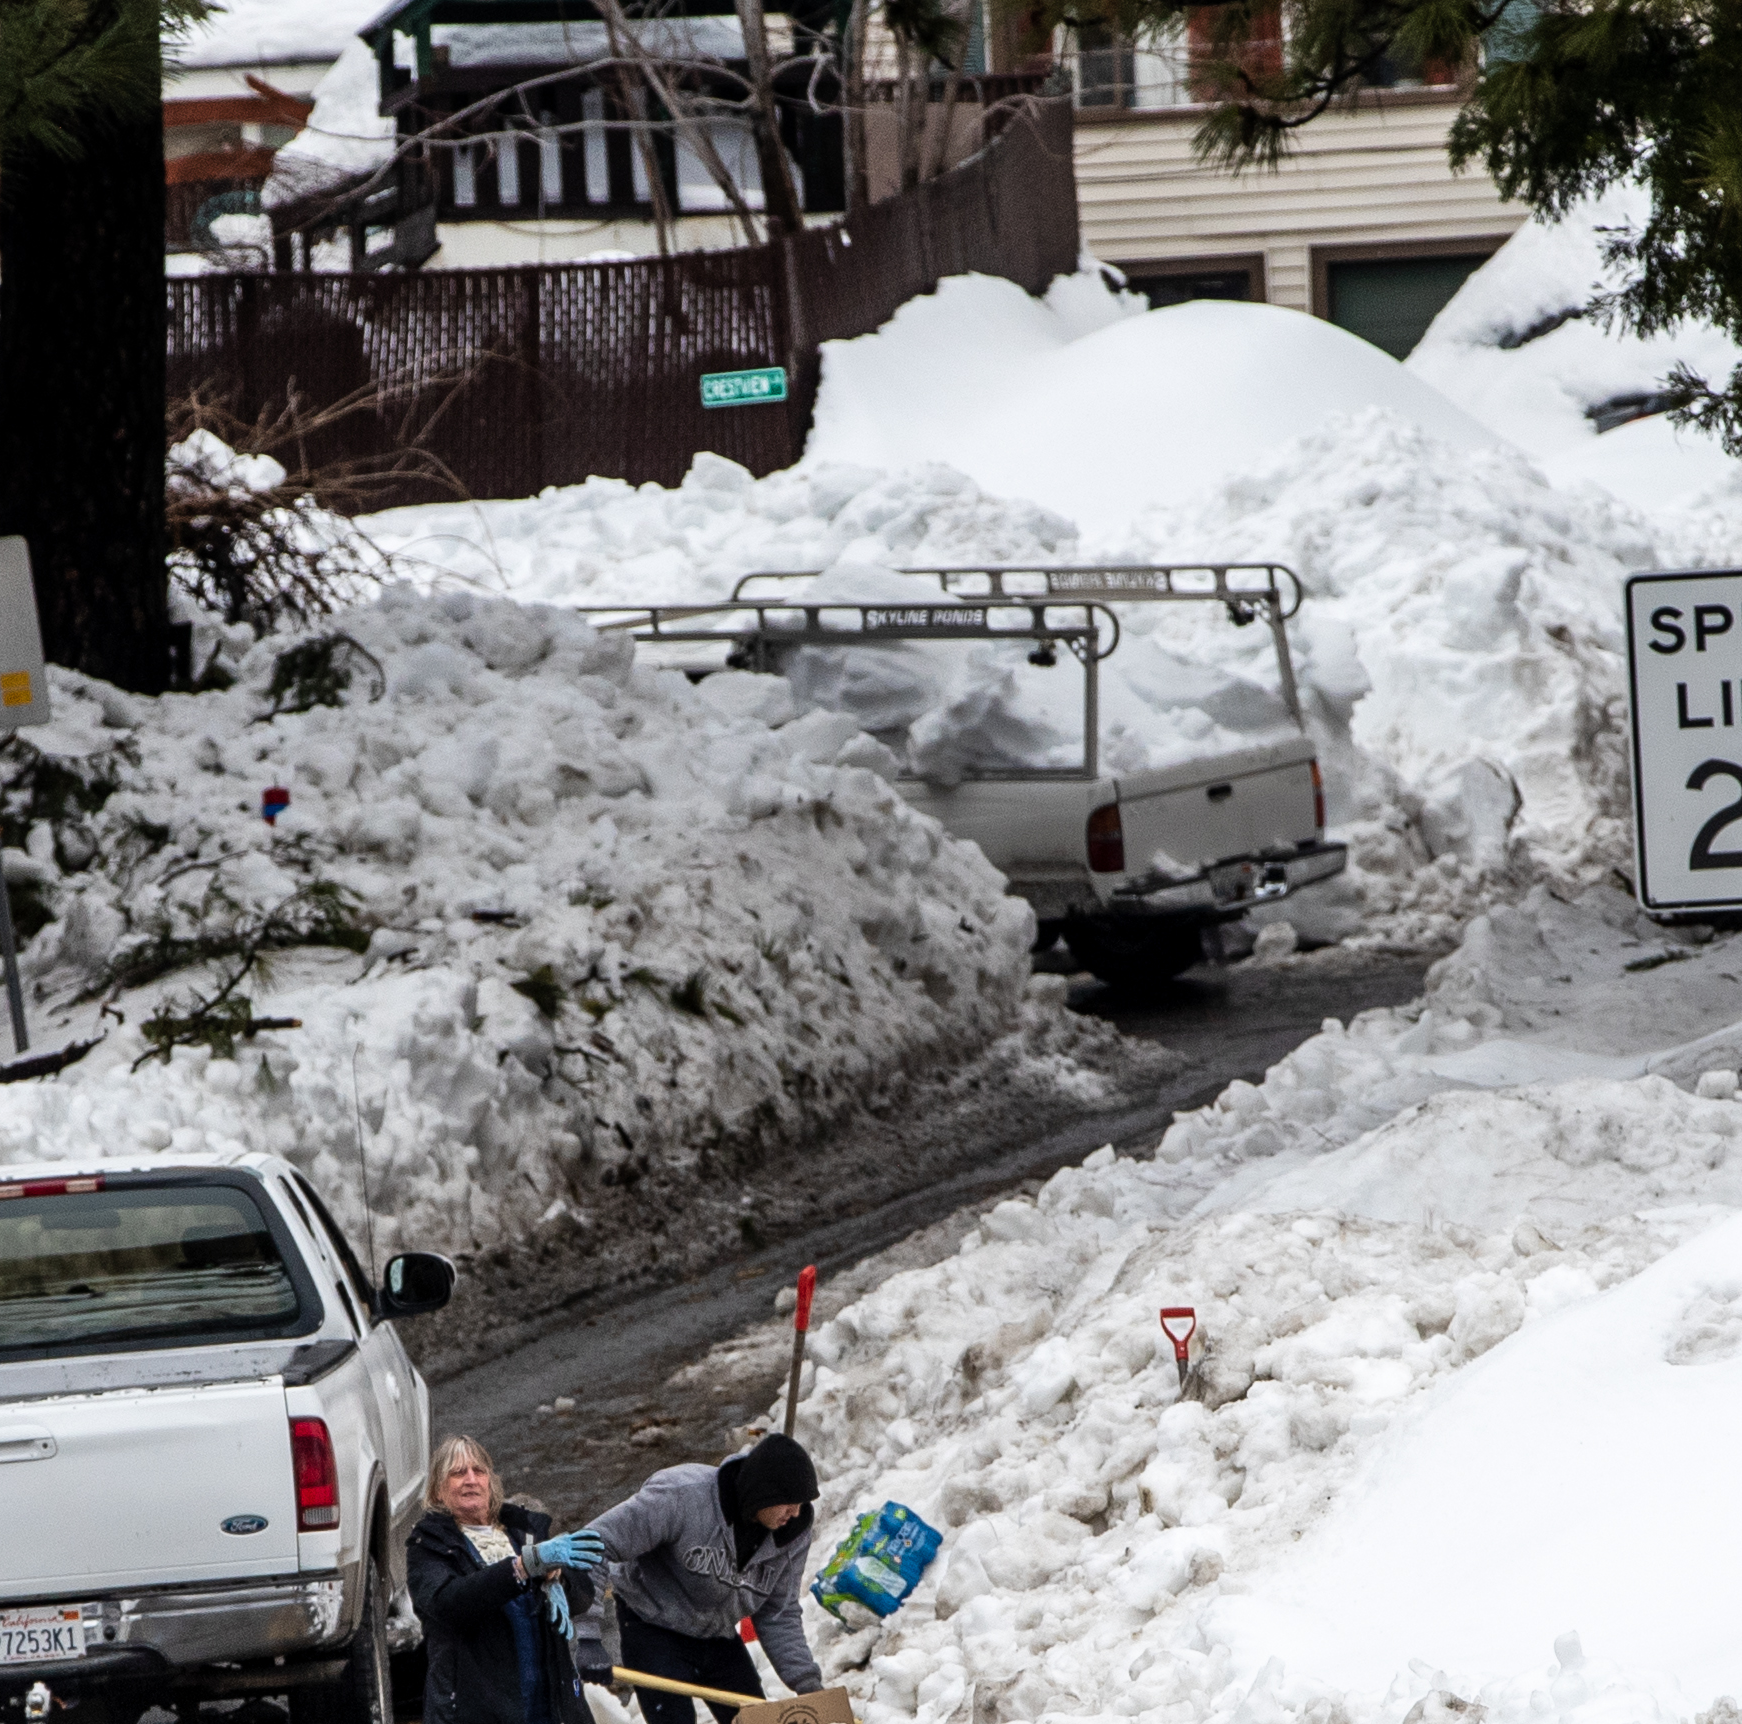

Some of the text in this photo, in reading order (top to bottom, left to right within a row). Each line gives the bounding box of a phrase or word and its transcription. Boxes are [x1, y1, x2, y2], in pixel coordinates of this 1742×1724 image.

[703, 376, 769, 400] CRESTVIEW
[865, 608, 929, 630] SKYLINE
[1, 1614, 61, 1629] California
